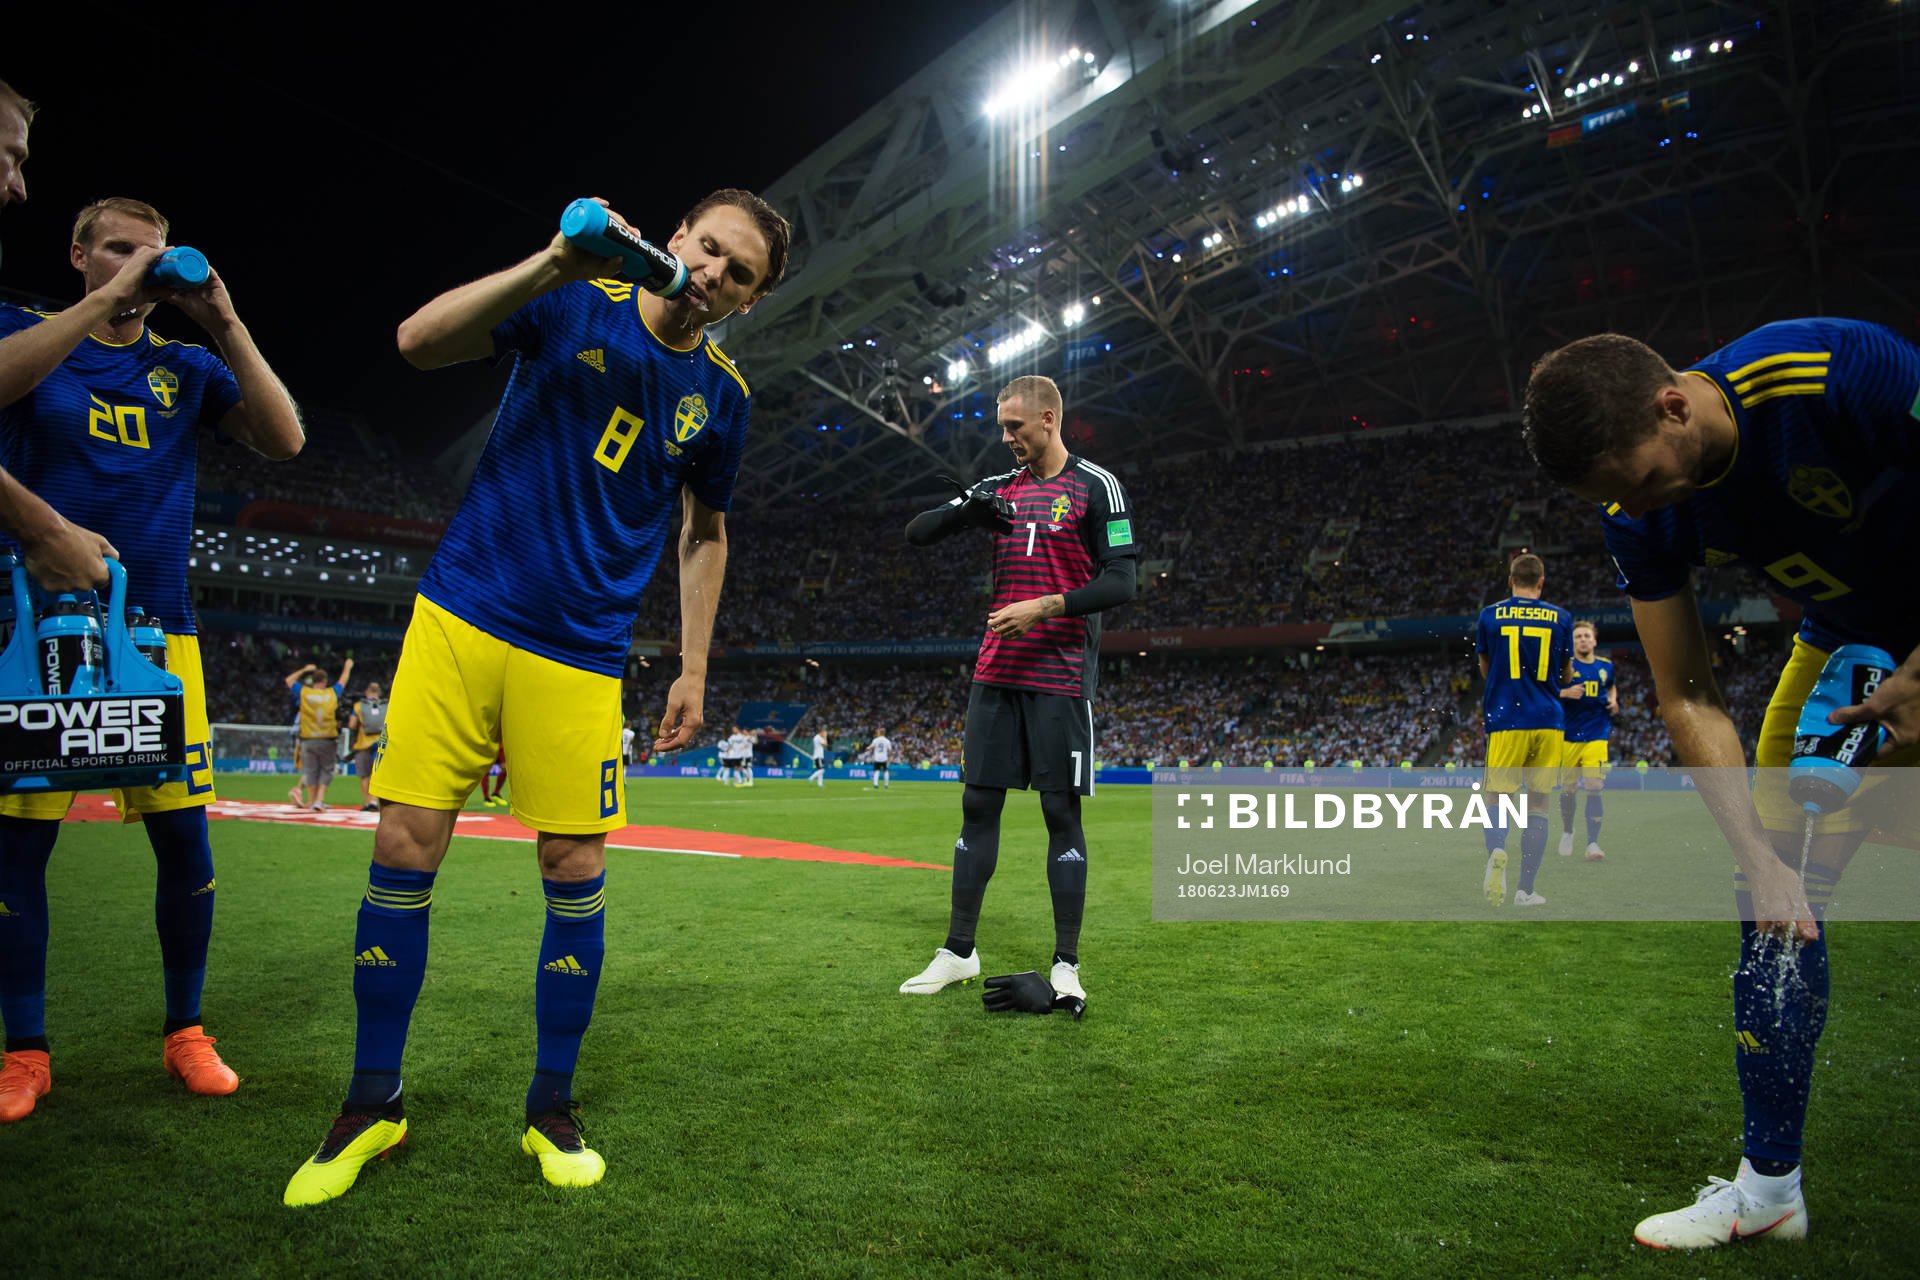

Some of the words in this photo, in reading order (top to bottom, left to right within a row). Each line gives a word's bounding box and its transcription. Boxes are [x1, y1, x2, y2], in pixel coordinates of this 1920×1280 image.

[1588, 108, 1626, 130] FIFA
[608, 217, 678, 271] POWERADE
[576, 352, 607, 374] adidas
[1068, 345, 1097, 361] FIFA
[89, 393, 151, 449] 20
[593, 406, 645, 473] 8
[1763, 552, 1853, 602] 9
[1495, 606, 1559, 623] CLAESSON
[45, 638, 62, 695] POWE
[1501, 625, 1553, 682] 17
[1584, 681, 1599, 697] 10
[0, 699, 167, 731] POWER
[1836, 667, 1883, 765] PORADE
[61, 725, 163, 756] ADE
[4, 758, 68, 771] OFFICIAL
[71, 755, 124, 768] SPORTS
[128, 752, 168, 764] DRINK
[185, 741, 213, 796] 2
[250, 760, 276, 772] FIFA
[1071, 750, 1083, 787] 1
[600, 758, 618, 819] 8
[1153, 772, 1177, 783] FIFA
[1280, 773, 1305, 785] FIFA
[544, 963, 589, 976] adidas
